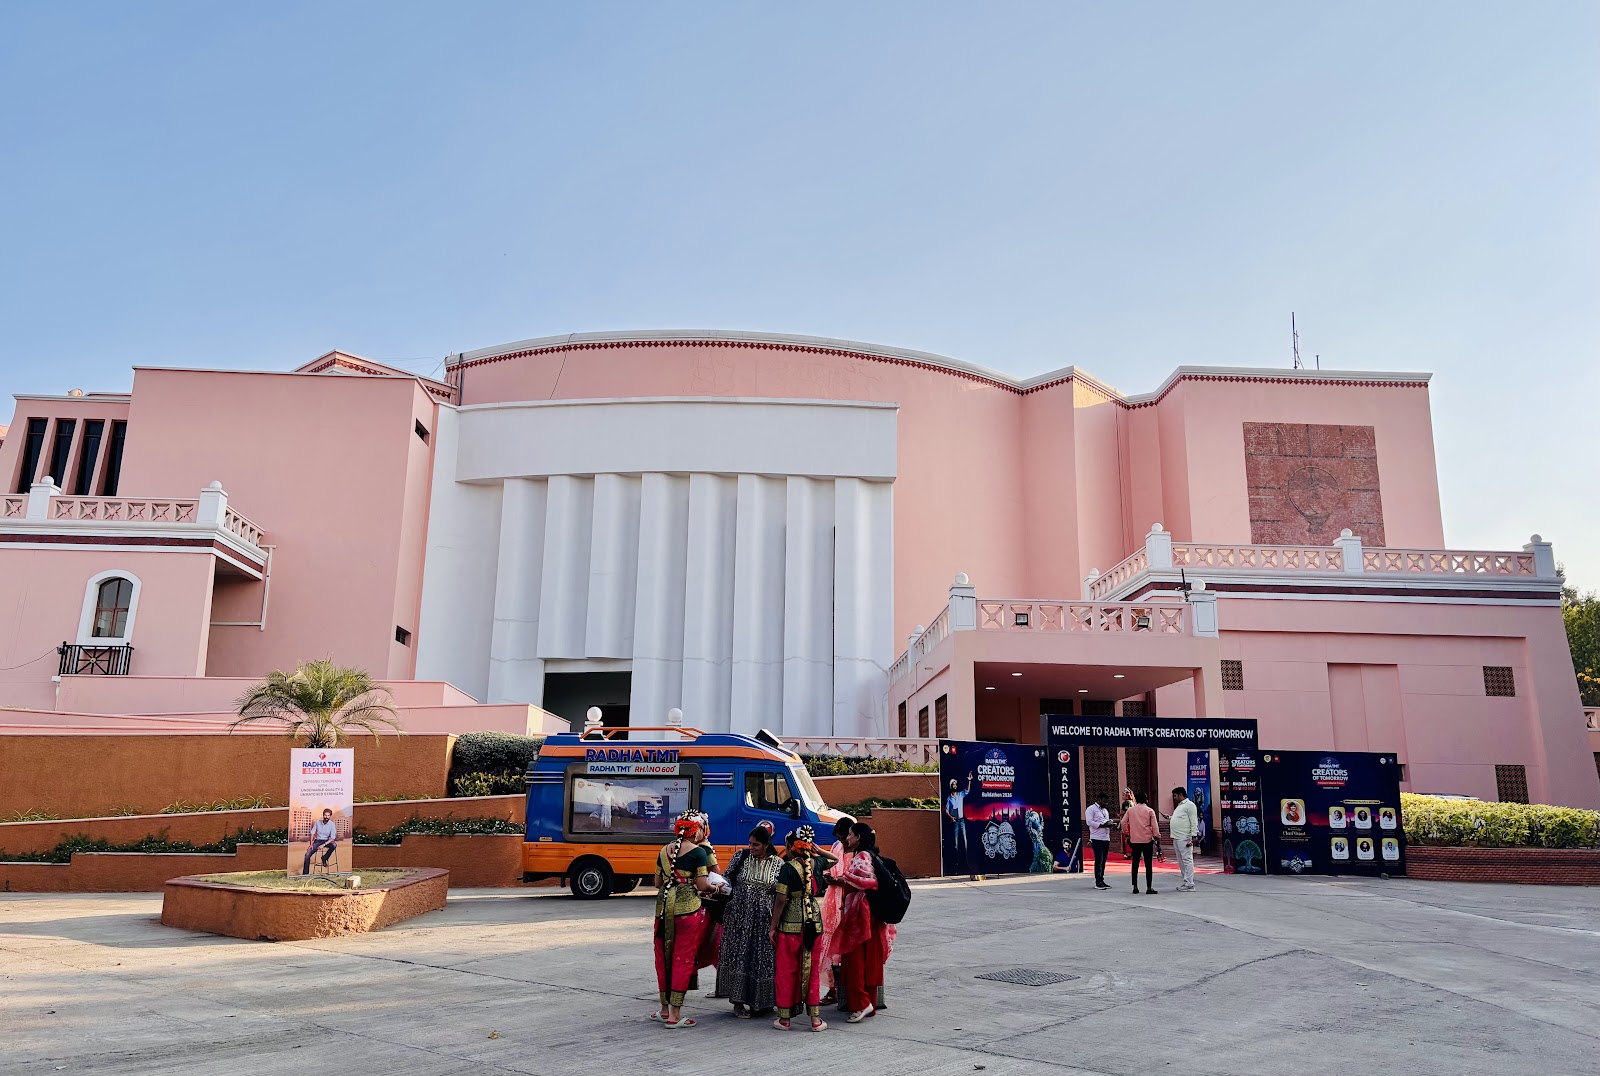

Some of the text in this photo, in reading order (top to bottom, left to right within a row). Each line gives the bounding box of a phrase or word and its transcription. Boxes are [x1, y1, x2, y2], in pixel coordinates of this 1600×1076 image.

[1051, 725, 1254, 739] WELCOME TO RADHA TMT'S CREATORS OF TOMORROW
[585, 748, 681, 763] RADHA TMT
[589, 765, 616, 773] RADHA
[616, 765, 631, 773] TMT
[661, 765, 676, 773] 600
[977, 765, 1015, 775] CREATORS
[1061, 767, 1069, 805] RADHA
